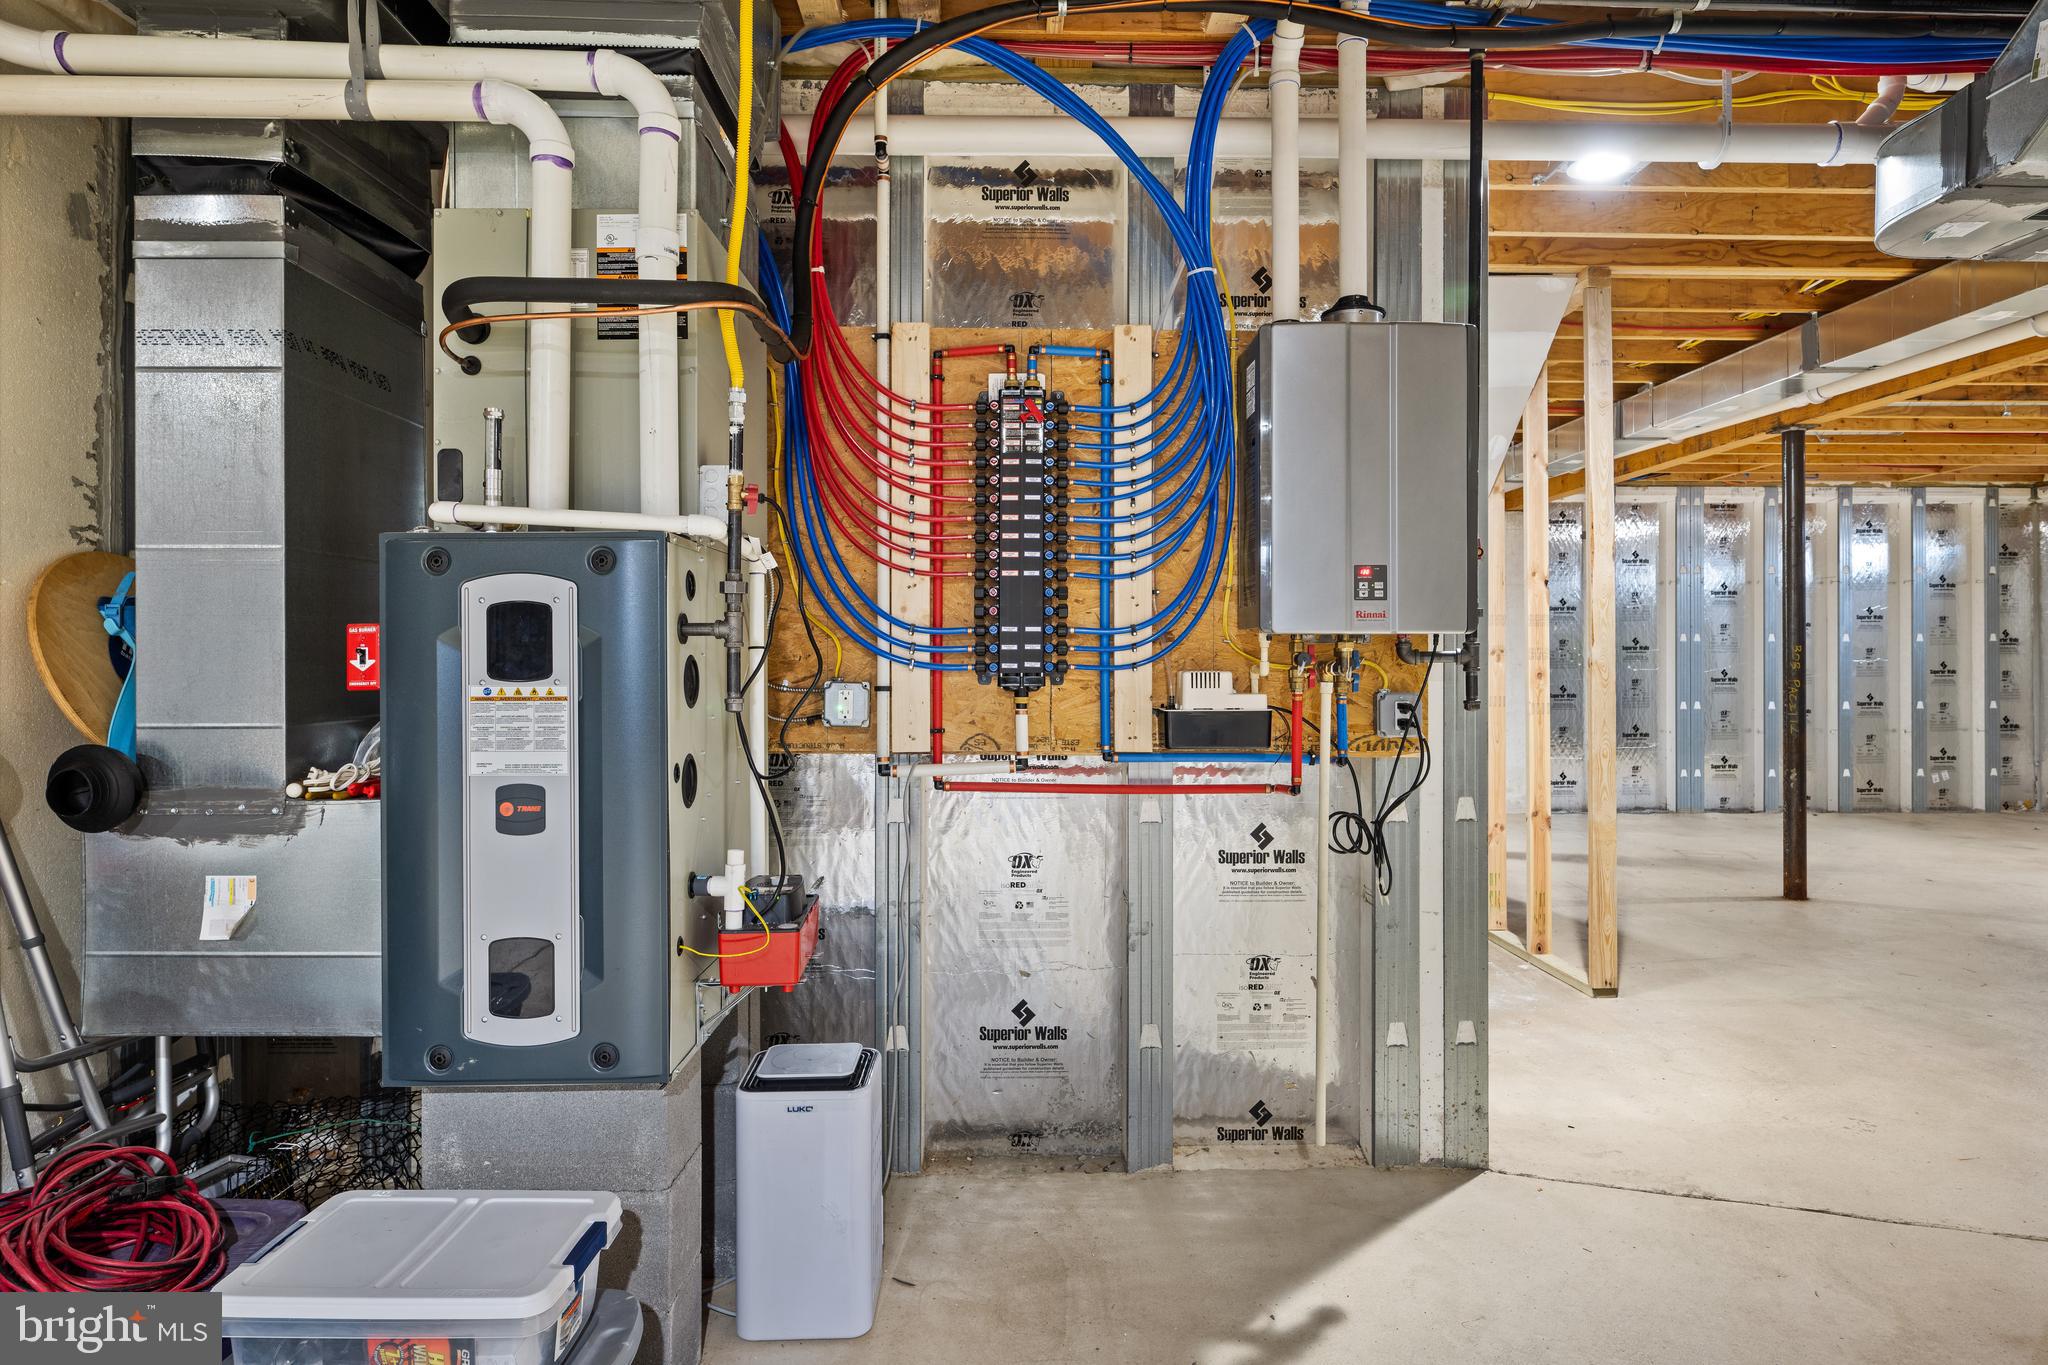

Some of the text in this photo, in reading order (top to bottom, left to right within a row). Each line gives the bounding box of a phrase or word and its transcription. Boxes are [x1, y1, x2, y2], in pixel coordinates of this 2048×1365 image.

[982, 187, 1069, 203] Superior Walls
[1220, 293, 1271, 308] Sperior
[1218, 850, 1305, 866] Superior Walls
[980, 1026, 1067, 1043] Superior Walls
[1217, 1126, 1304, 1143] Superior Walls
